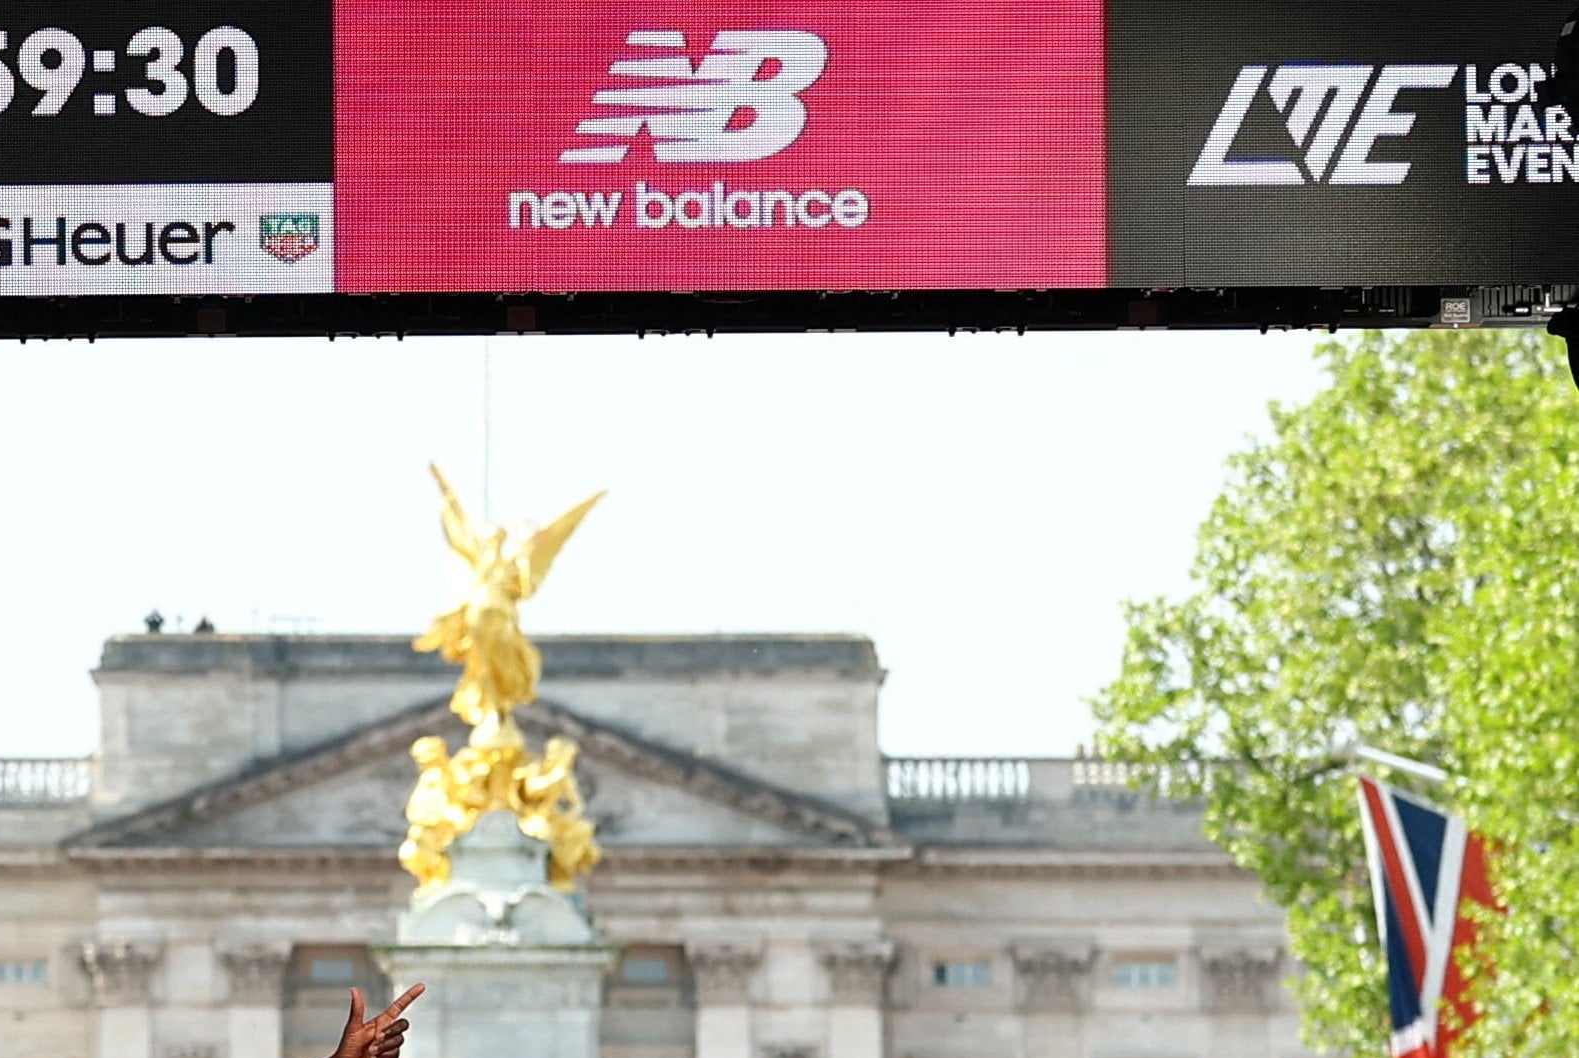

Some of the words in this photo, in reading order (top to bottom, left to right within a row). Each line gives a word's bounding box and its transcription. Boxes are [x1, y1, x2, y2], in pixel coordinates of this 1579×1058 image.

[1466, 105, 1579, 141] MAR
[508, 188, 624, 230] new
[635, 181, 871, 230] balance
